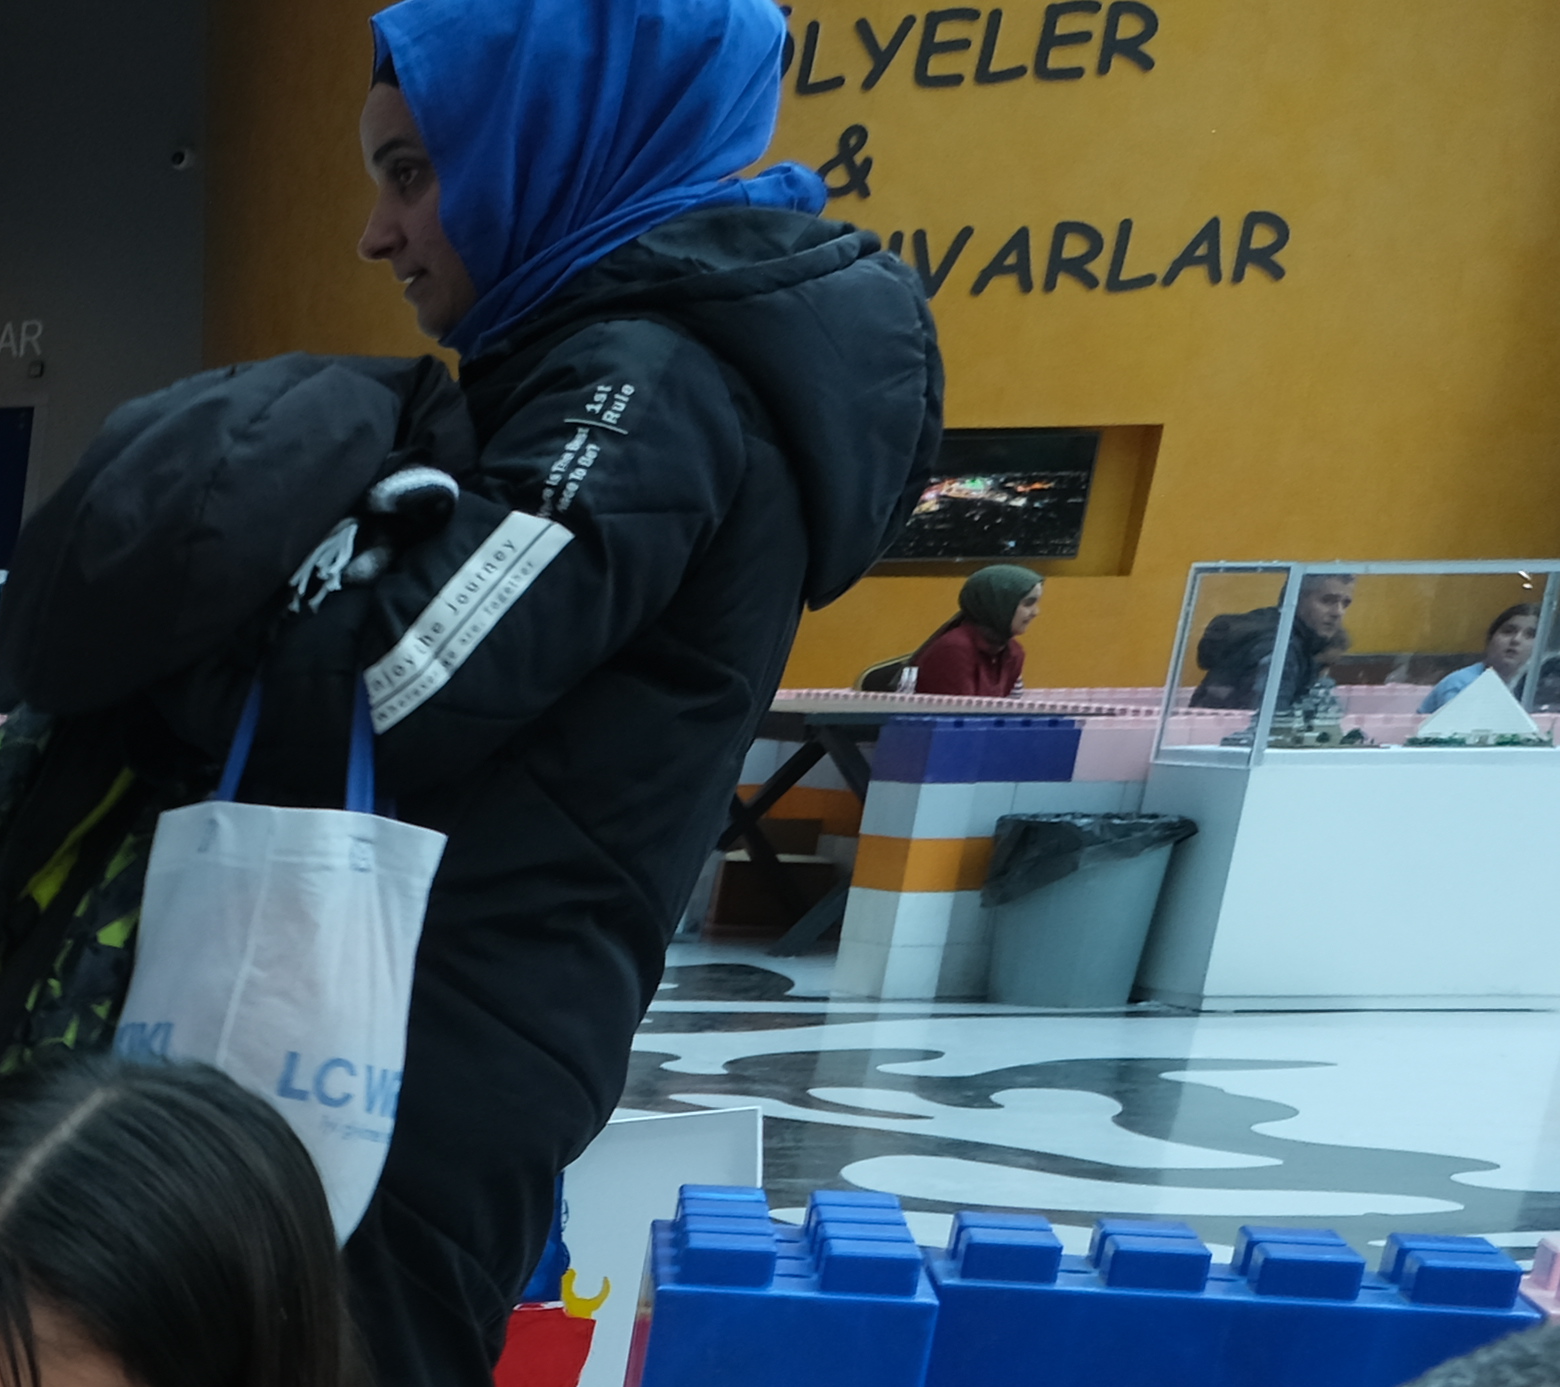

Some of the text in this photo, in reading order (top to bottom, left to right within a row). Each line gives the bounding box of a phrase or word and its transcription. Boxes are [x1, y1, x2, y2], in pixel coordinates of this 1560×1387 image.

[780, 0, 1159, 95] LYELER
[817, 124, 873, 199] &
[889, 211, 1290, 300] VARLAR
[601, 383, 636, 425] Rule
[276, 1050, 358, 1108] LC
